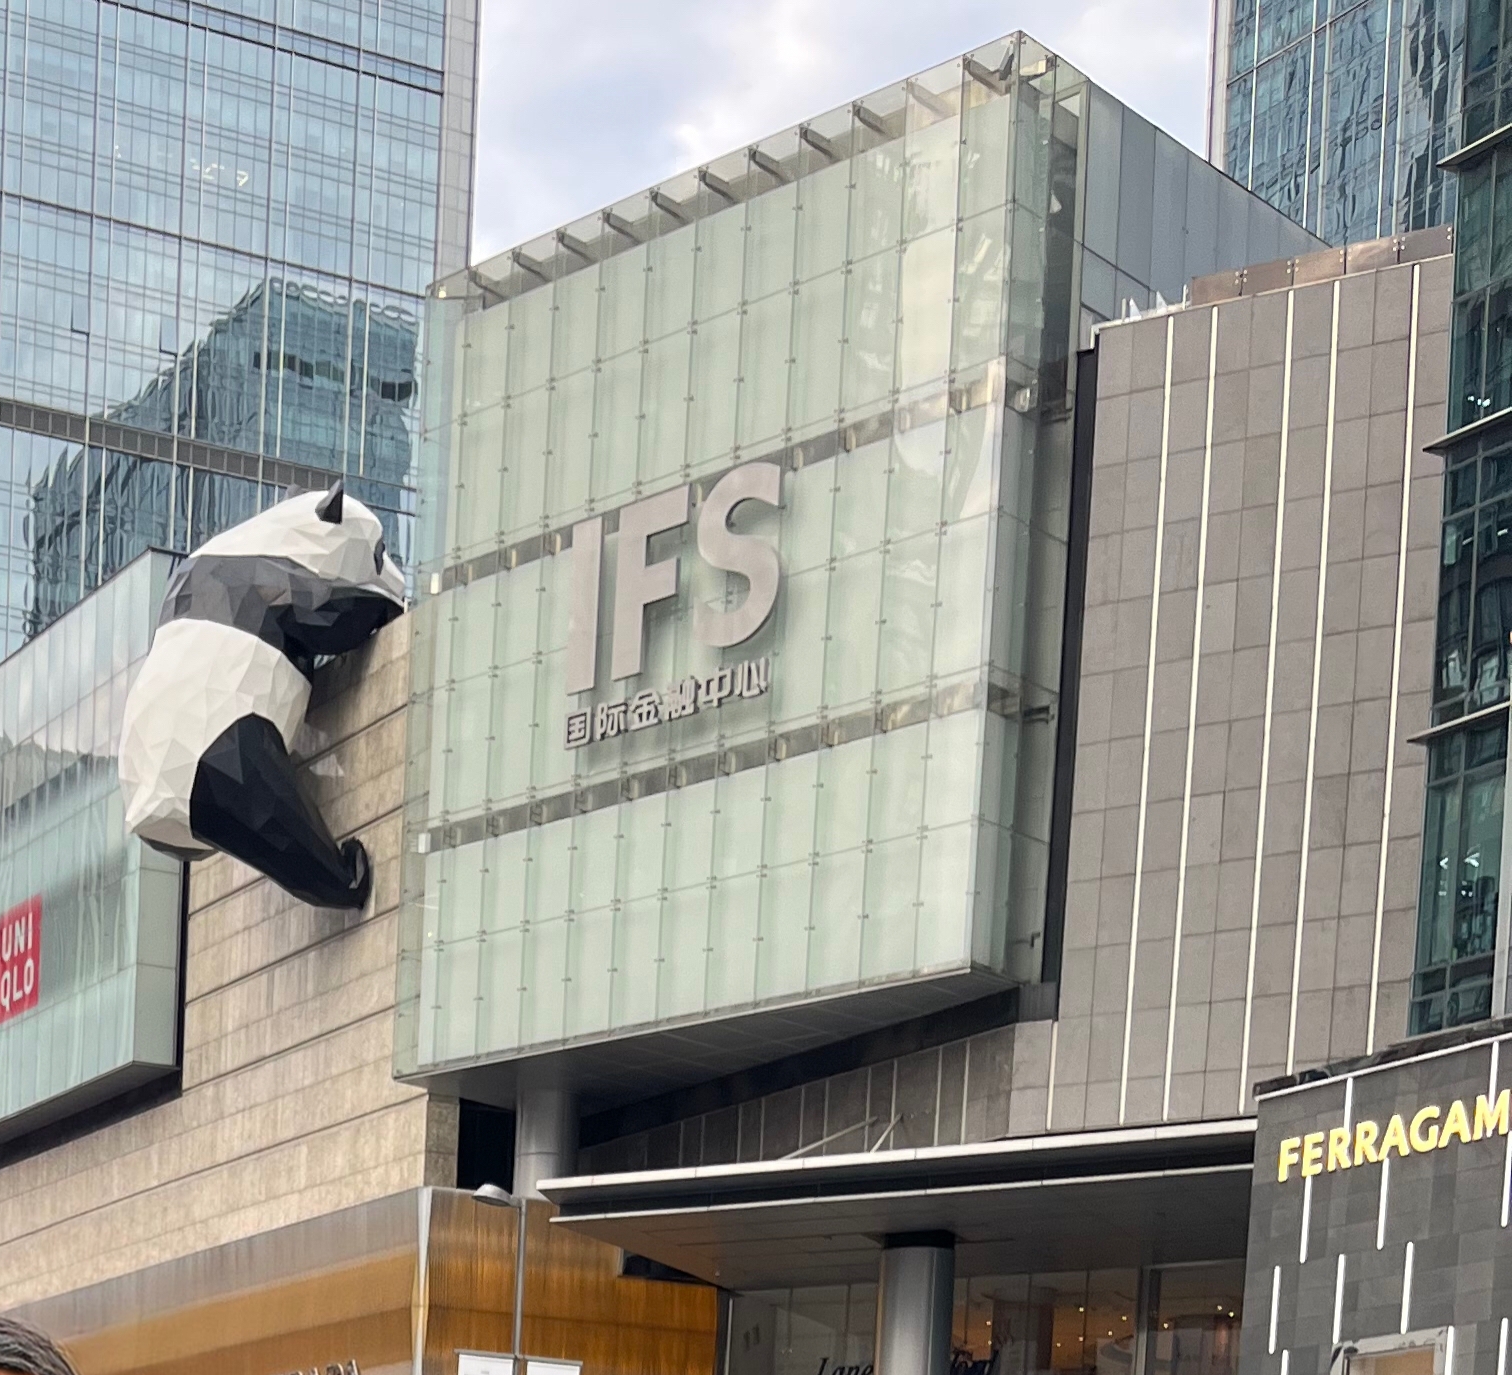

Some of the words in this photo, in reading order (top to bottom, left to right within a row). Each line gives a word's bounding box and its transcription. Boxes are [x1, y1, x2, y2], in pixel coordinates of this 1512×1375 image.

[566, 461, 782, 696] IFS
[564, 657, 771, 750] 国际金融中心
[1, 912, 33, 962] UNI
[0, 957, 34, 1012] QLO
[1277, 1089, 1511, 1184] FERRAGAM
